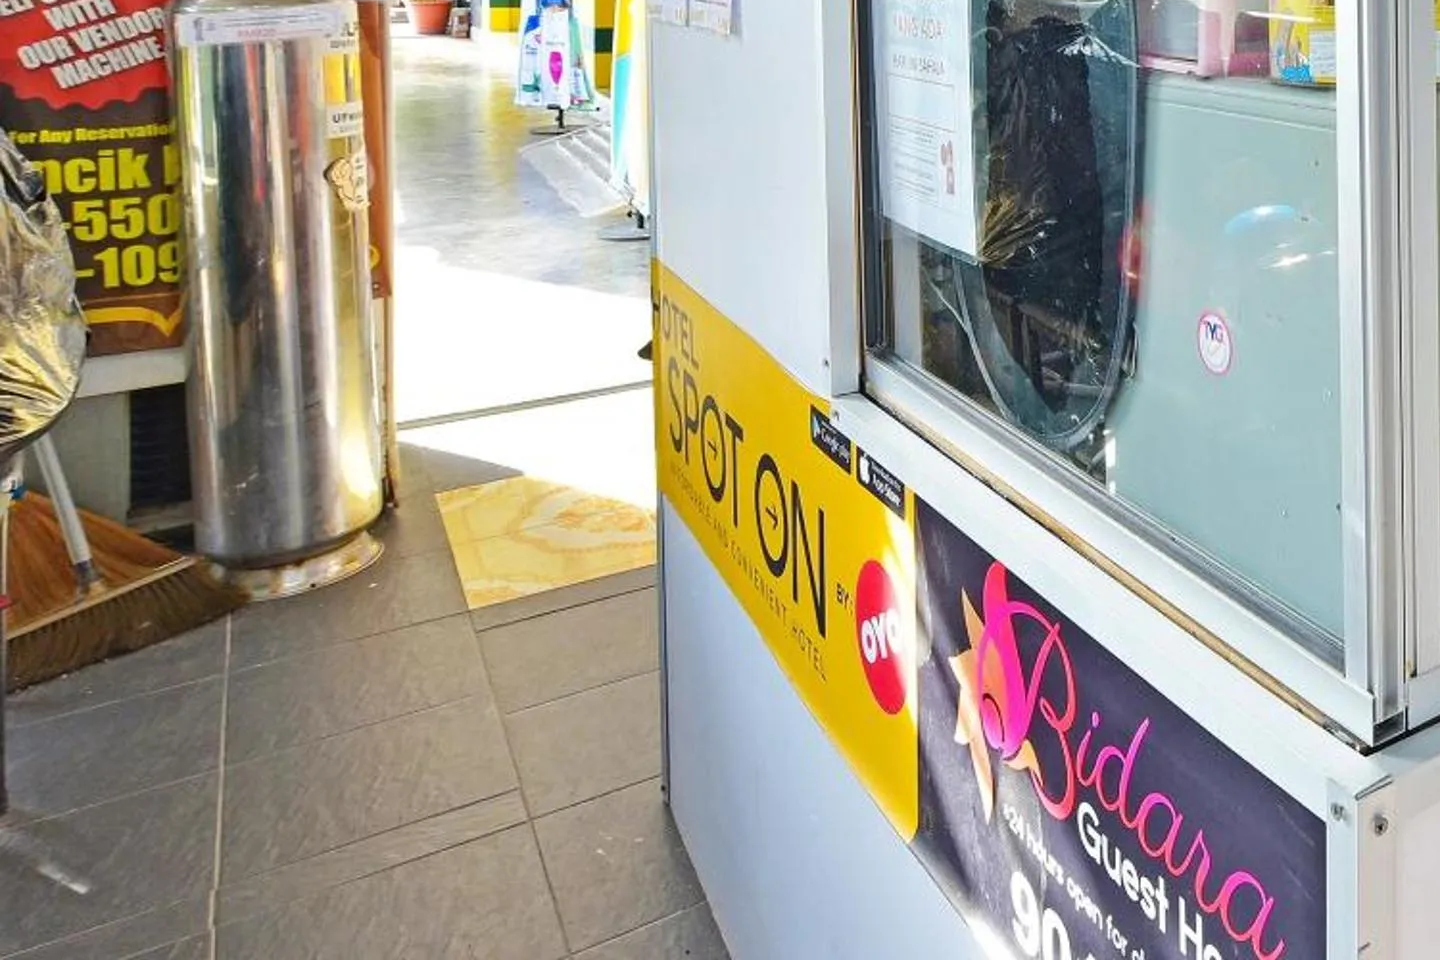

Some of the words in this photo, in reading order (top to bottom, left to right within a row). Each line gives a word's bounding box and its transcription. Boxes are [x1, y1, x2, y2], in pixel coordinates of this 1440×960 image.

[17, 35, 76, 70] OUR
[39, 129, 73, 145] Any
[651, 286, 700, 371] HOTEL
[666, 356, 743, 528] SPOT
[755, 453, 827, 639] ON
[1006, 600, 1286, 960] Bidara
[1077, 802, 1168, 933] Guest
[1066, 876, 1104, 931] open
[1106, 915, 1128, 957] for
